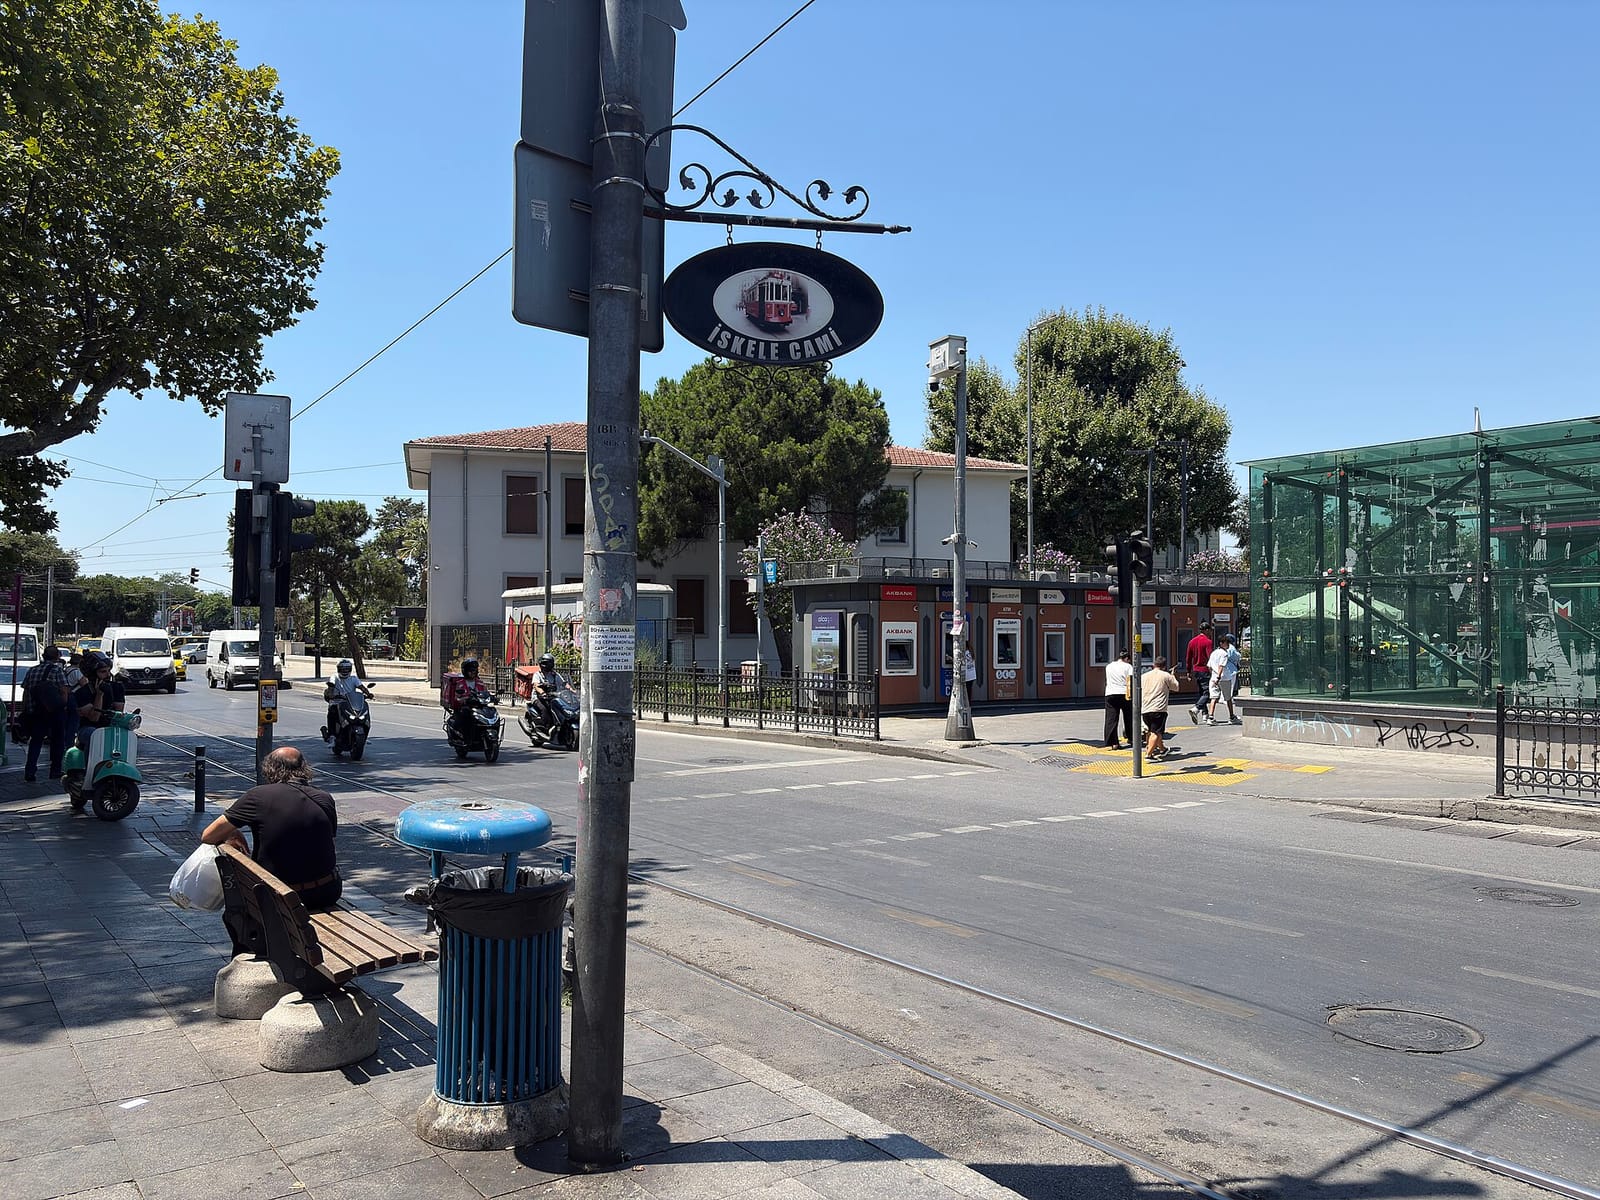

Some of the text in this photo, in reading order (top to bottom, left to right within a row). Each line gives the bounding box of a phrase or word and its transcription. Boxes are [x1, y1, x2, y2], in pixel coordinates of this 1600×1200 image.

[707, 323, 843, 361] İSKELE CAMİ
[1173, 594, 1187, 603] ING
